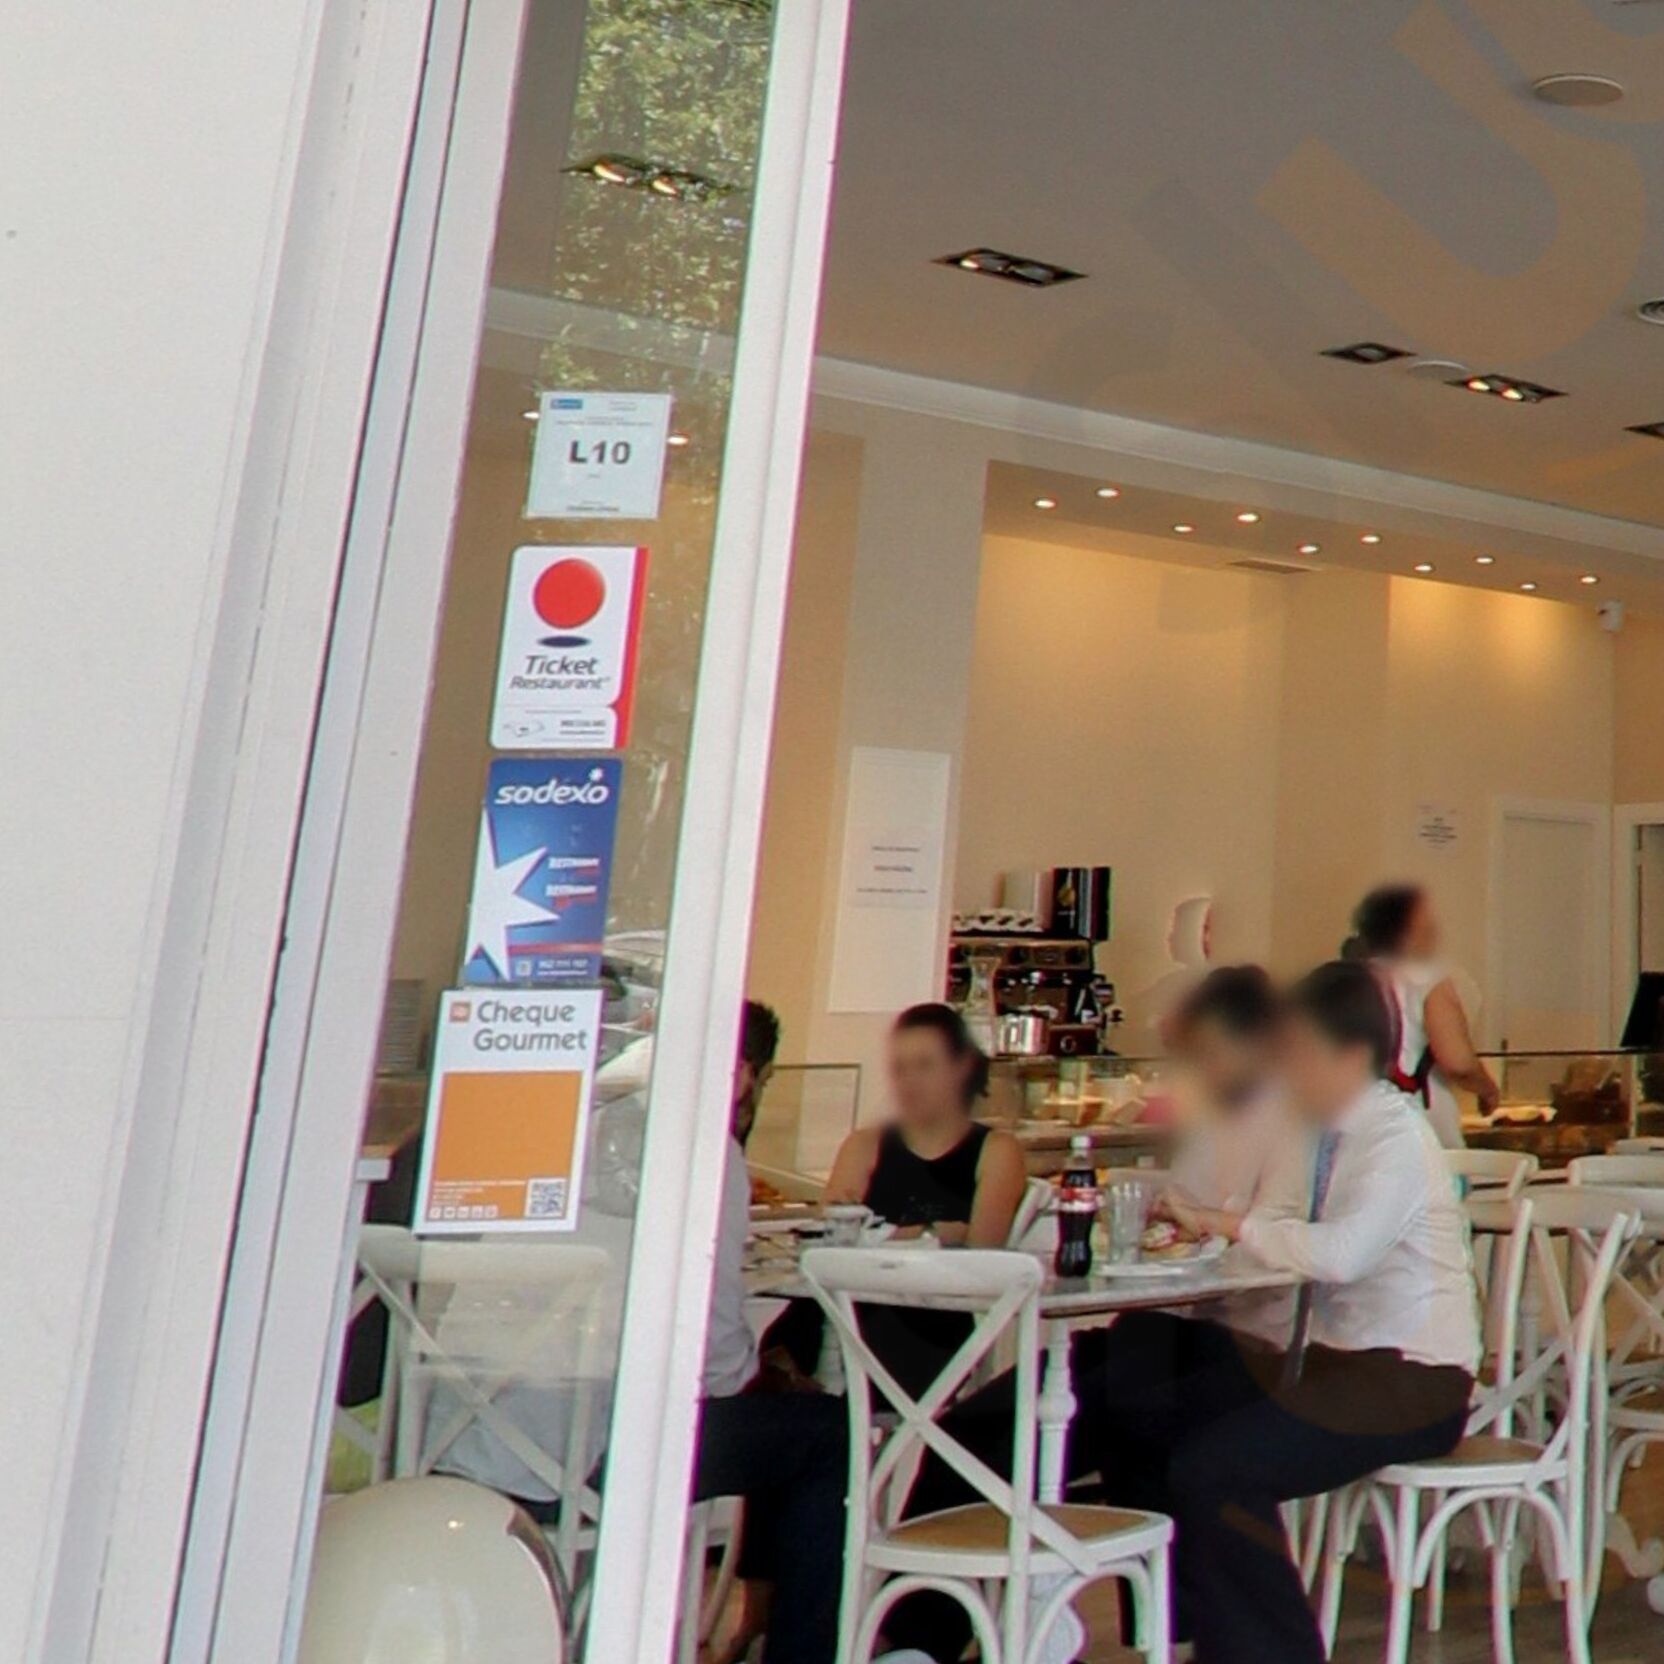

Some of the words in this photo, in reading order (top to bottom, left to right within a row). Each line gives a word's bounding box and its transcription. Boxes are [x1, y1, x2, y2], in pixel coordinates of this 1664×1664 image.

[568, 440, 631, 465] L10
[525, 655, 598, 675] Ticket
[494, 778, 609, 805] sodexo
[477, 1000, 576, 1027] Cheque
[473, 1028, 588, 1052] Gourmet
